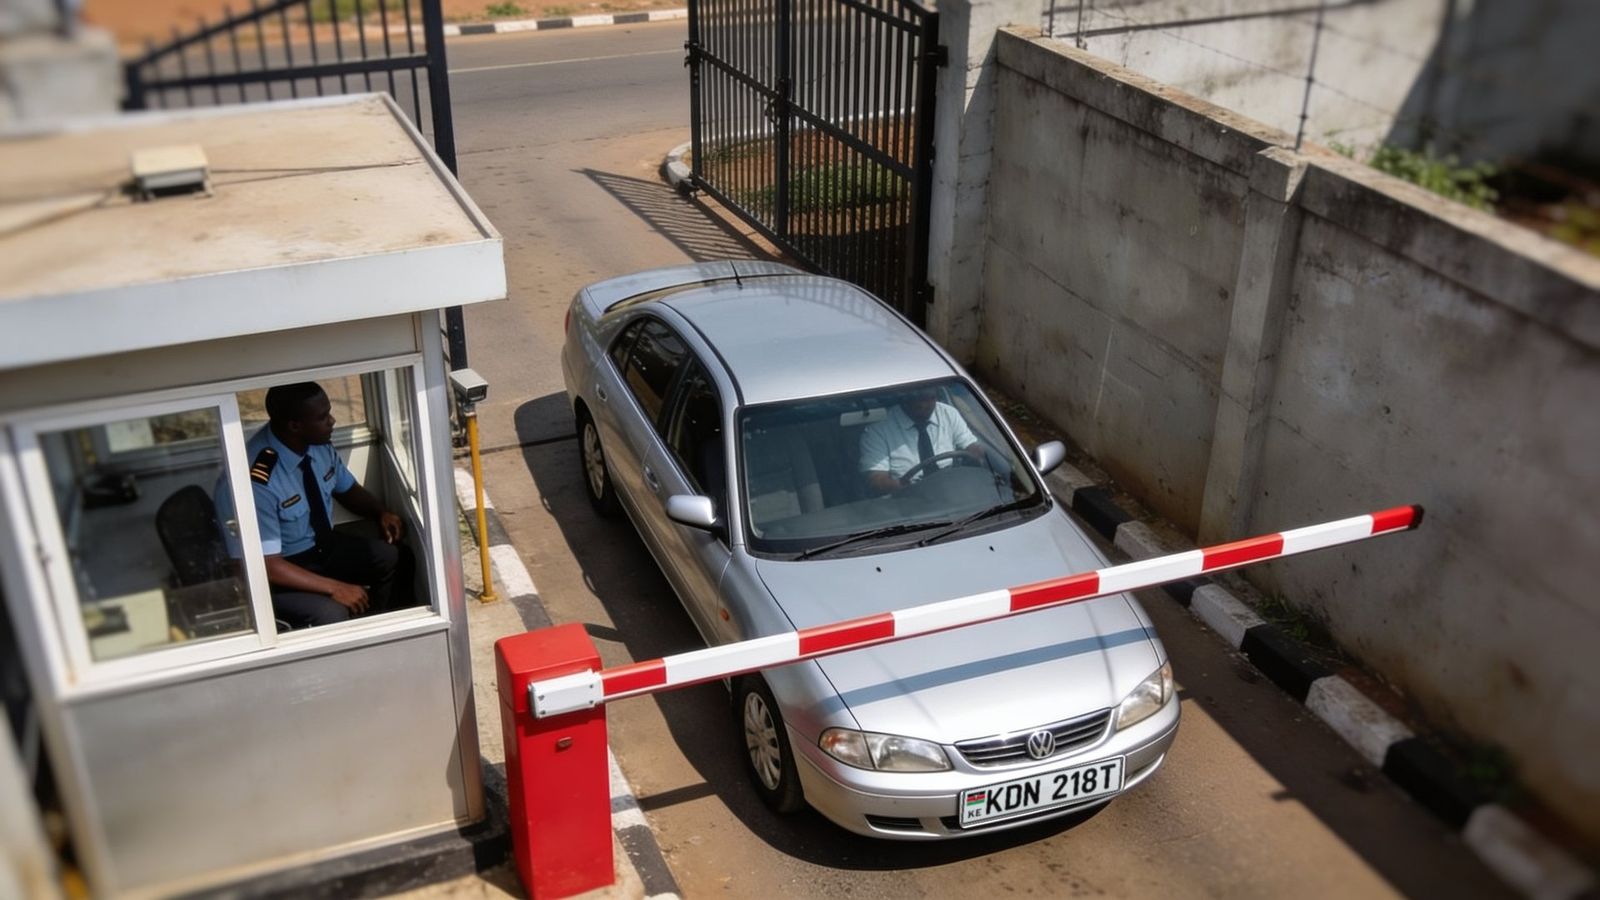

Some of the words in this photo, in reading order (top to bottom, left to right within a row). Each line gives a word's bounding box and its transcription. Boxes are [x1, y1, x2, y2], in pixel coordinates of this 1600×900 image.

[985, 780, 1041, 815] KDN
[1052, 763, 1116, 800] 218T
[967, 808, 982, 819] KE
